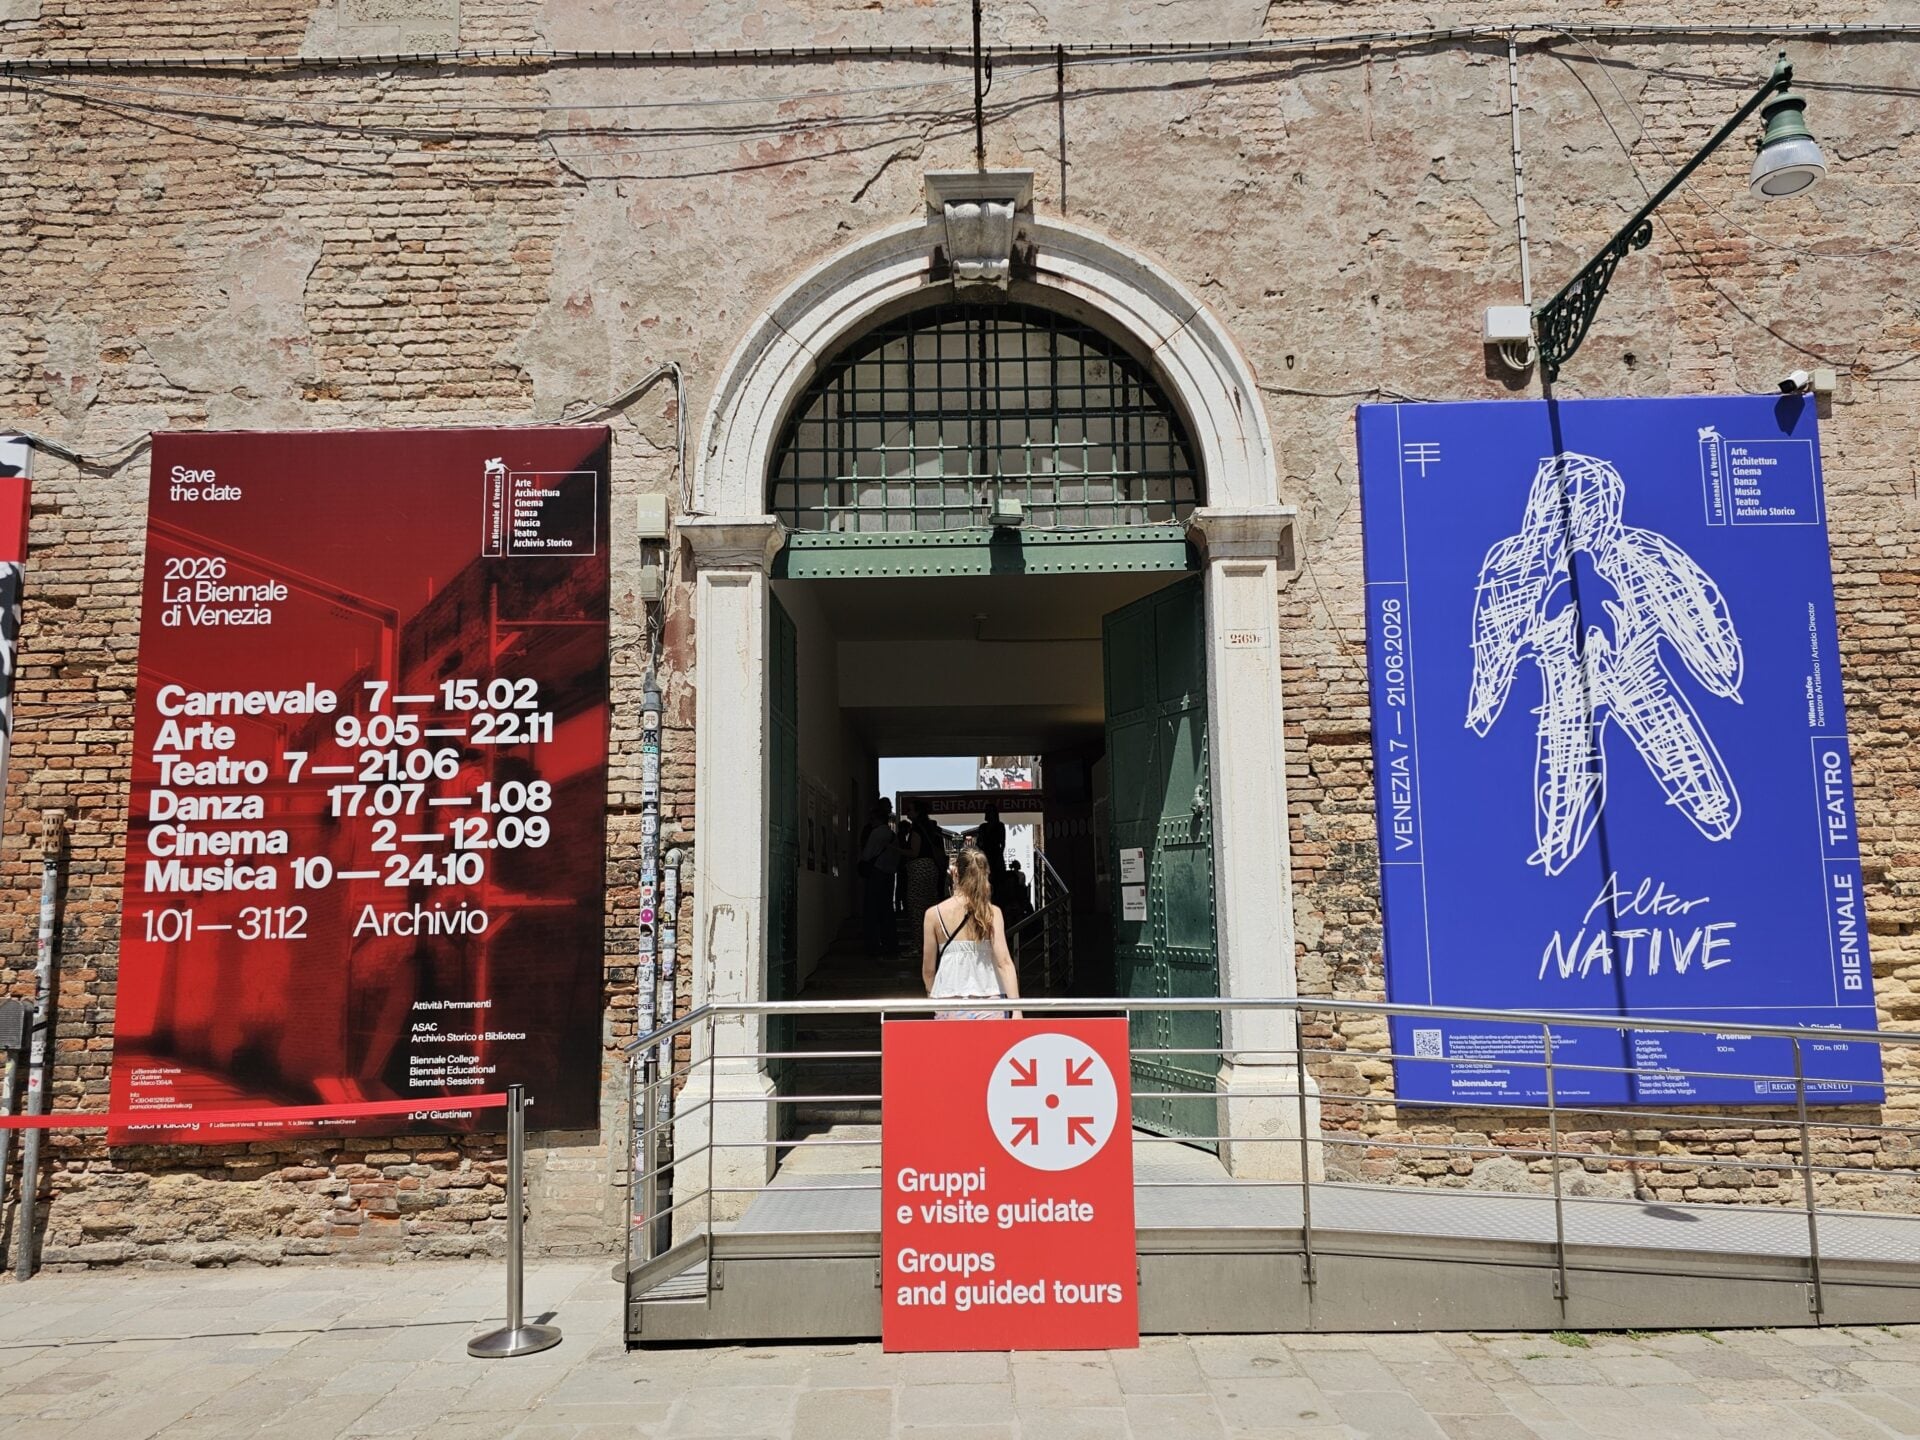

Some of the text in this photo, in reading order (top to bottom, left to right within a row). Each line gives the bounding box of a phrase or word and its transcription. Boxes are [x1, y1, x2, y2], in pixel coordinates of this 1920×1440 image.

[1708, 443, 1718, 469] Venezia
[1732, 457, 1777, 465] Architettura
[171, 466, 216, 483] Save
[515, 479, 531, 487] Arte
[1733, 467, 1762, 476] Cinema
[1734, 478, 1757, 486] Danza
[170, 484, 242, 501] the date
[493, 475, 502, 500] Venezia
[515, 489, 560, 497] Architettura
[1712, 479, 1721, 507] Biennale
[1735, 487, 1761, 496] Musica
[492, 501, 500, 509] di
[514, 499, 544, 507] Cinema
[514, 509, 538, 517] Danza
[1735, 498, 1759, 506] Teatro
[1736, 507, 1795, 516] Archivio Storico
[492, 511, 500, 540] Biennale
[513, 529, 538, 537] Teatro
[514, 519, 540, 527] Musica
[513, 538, 573, 548] Archivio Storico
[164, 557, 227, 579] 2026
[163, 580, 288, 603] La Biennale
[161, 603, 272, 627] di Venezia
[1808, 602, 1817, 631] Director
[1382, 598, 1405, 707] 21.06.2026
[1810, 632, 1819, 658] Artistic
[1814, 662, 1822, 693] Artistico
[155, 683, 338, 717] Carnevale
[1805, 676, 1816, 727] Willem Dafoe
[1817, 694, 1825, 727] Direttore
[152, 719, 236, 751] Arte
[1389, 739, 1409, 752] 7
[152, 754, 269, 786] Teatro
[148, 789, 264, 822] Danza
[1390, 755, 1414, 851] VENEZIA
[1822, 751, 1849, 846] TEATRO
[147, 824, 288, 857] Cinema
[144, 858, 277, 893] Musica
[1583, 871, 1710, 925] Alter
[353, 901, 488, 938] Archivio
[1834, 874, 1863, 990] BIENNALE
[1538, 922, 1737, 980] NATIVE
[412, 999, 492, 1010] Attività Permanenti
[411, 1023, 438, 1032] ASAC
[411, 1033, 446, 1043] Archivio
[447, 1032, 477, 1042] Storico
[484, 1031, 526, 1041] Biblioteca
[409, 1065, 496, 1076] Biennale Educational
[410, 1055, 480, 1065] Biennale College
[409, 1076, 485, 1087] Biennale Sessions
[1452, 1080, 1507, 1088] labiennale.org
[415, 1111, 429, 1120] Ca'
[430, 1110, 472, 1119] Giustinian
[897, 1166, 986, 1197] Gruppi
[896, 1198, 1095, 1229] e visite guidate
[897, 1247, 996, 1278] Groups
[896, 1279, 1123, 1312] and guided tours
